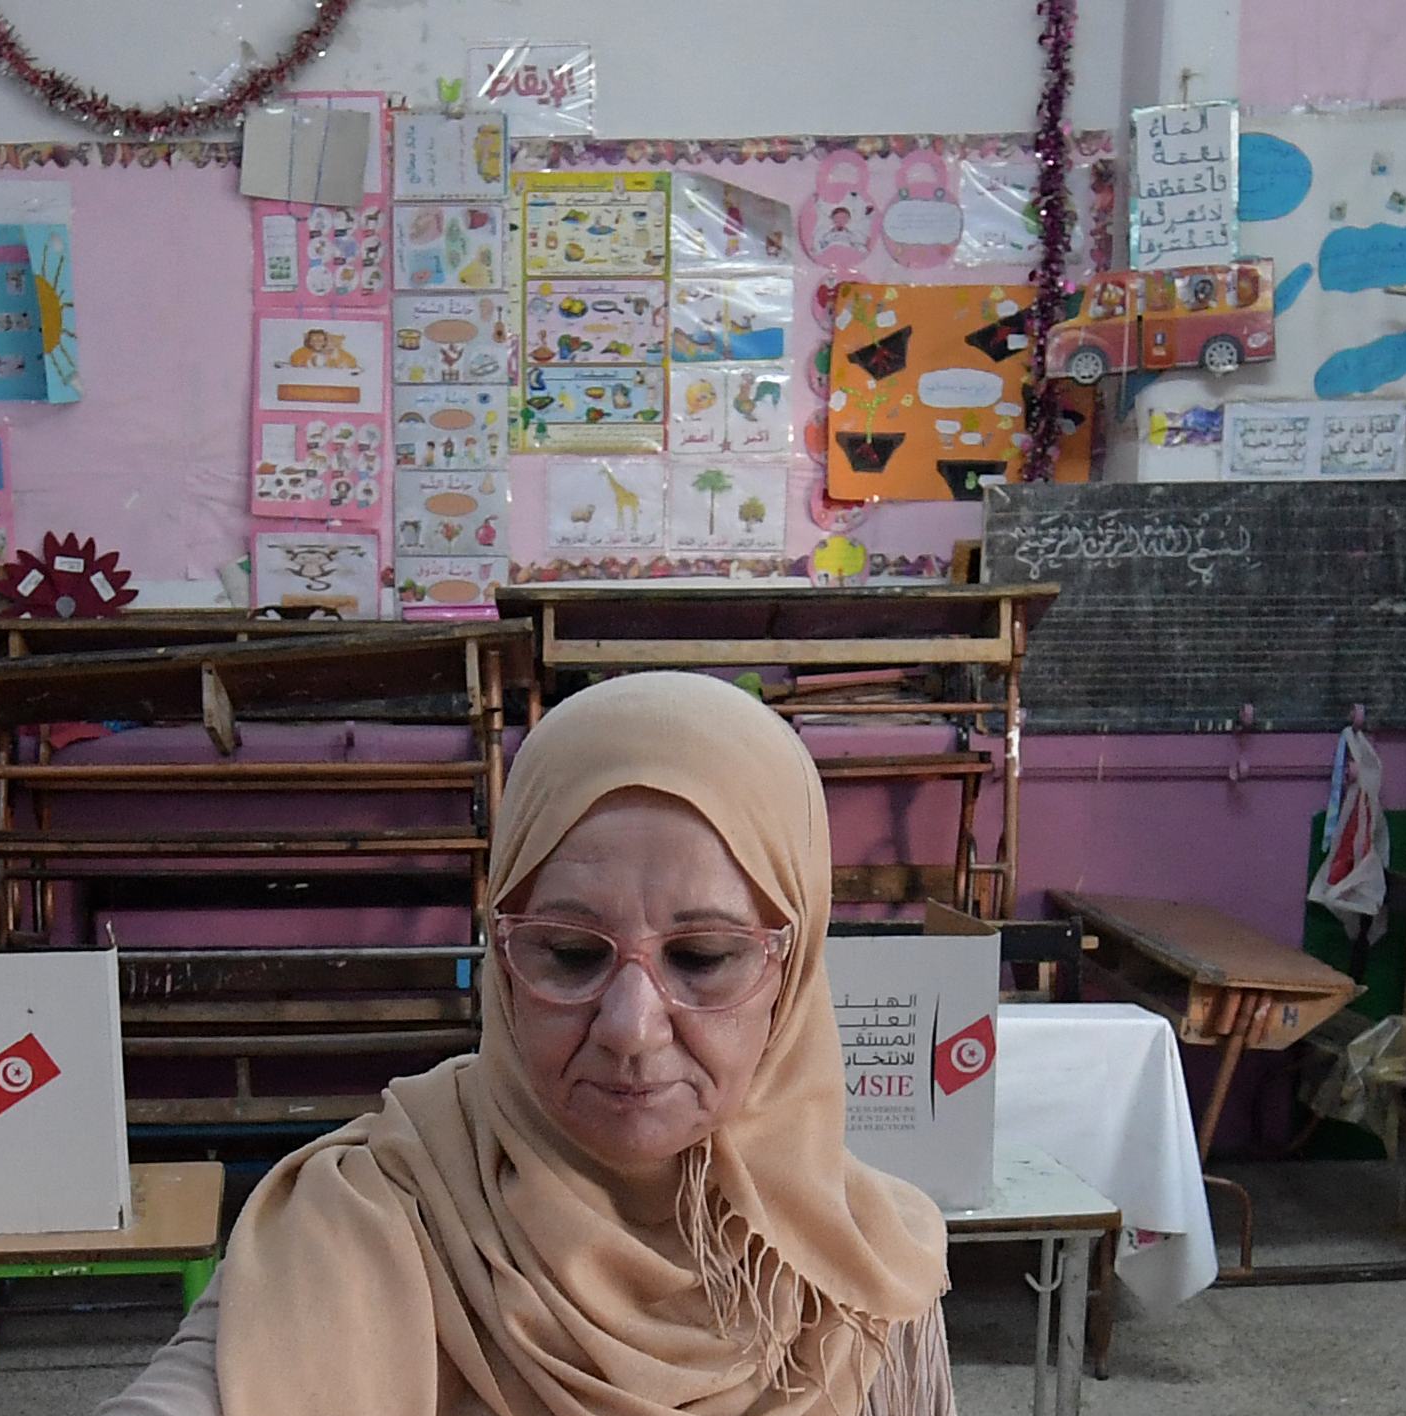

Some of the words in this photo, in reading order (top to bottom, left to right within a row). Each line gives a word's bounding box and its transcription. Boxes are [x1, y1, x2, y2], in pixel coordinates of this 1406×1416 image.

[834, 994, 916, 1011] الهيئ
[838, 1013, 916, 1030] العلي
[842, 1032, 915, 1047] المستق
